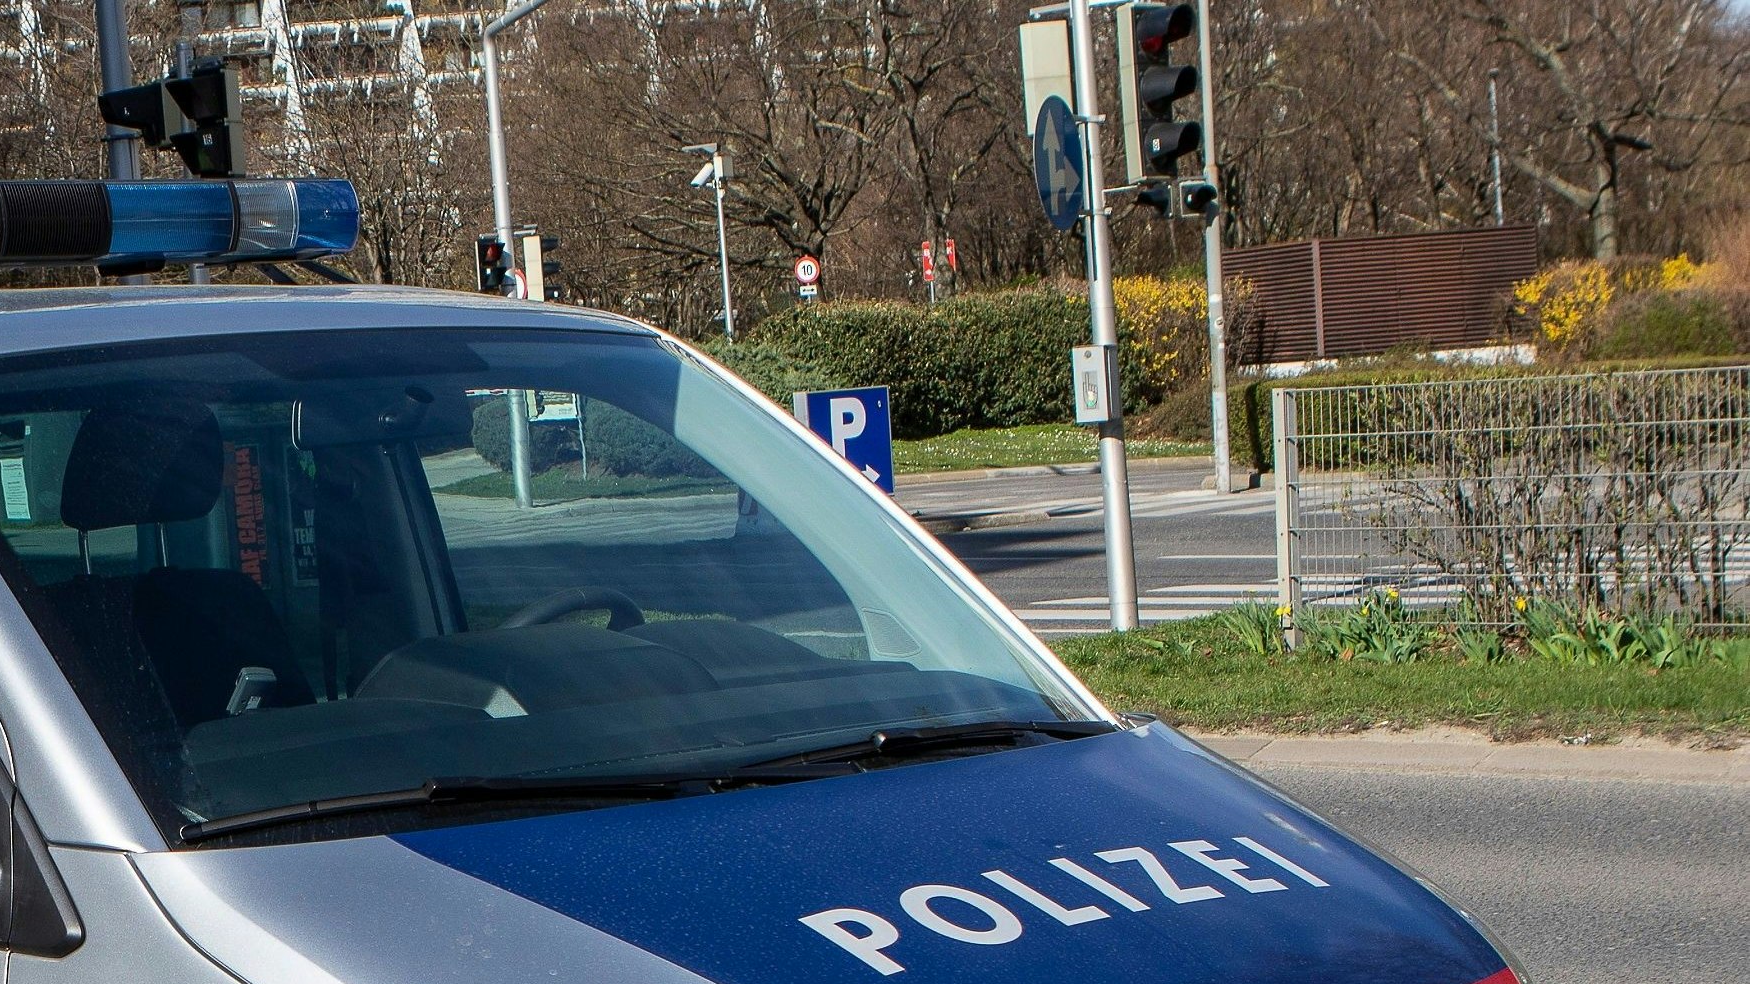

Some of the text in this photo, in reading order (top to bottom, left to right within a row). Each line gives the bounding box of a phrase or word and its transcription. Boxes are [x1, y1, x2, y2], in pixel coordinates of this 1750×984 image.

[802, 265, 813, 276] 10
[829, 397, 867, 459] P
[798, 836, 1330, 977] POLIZEI
